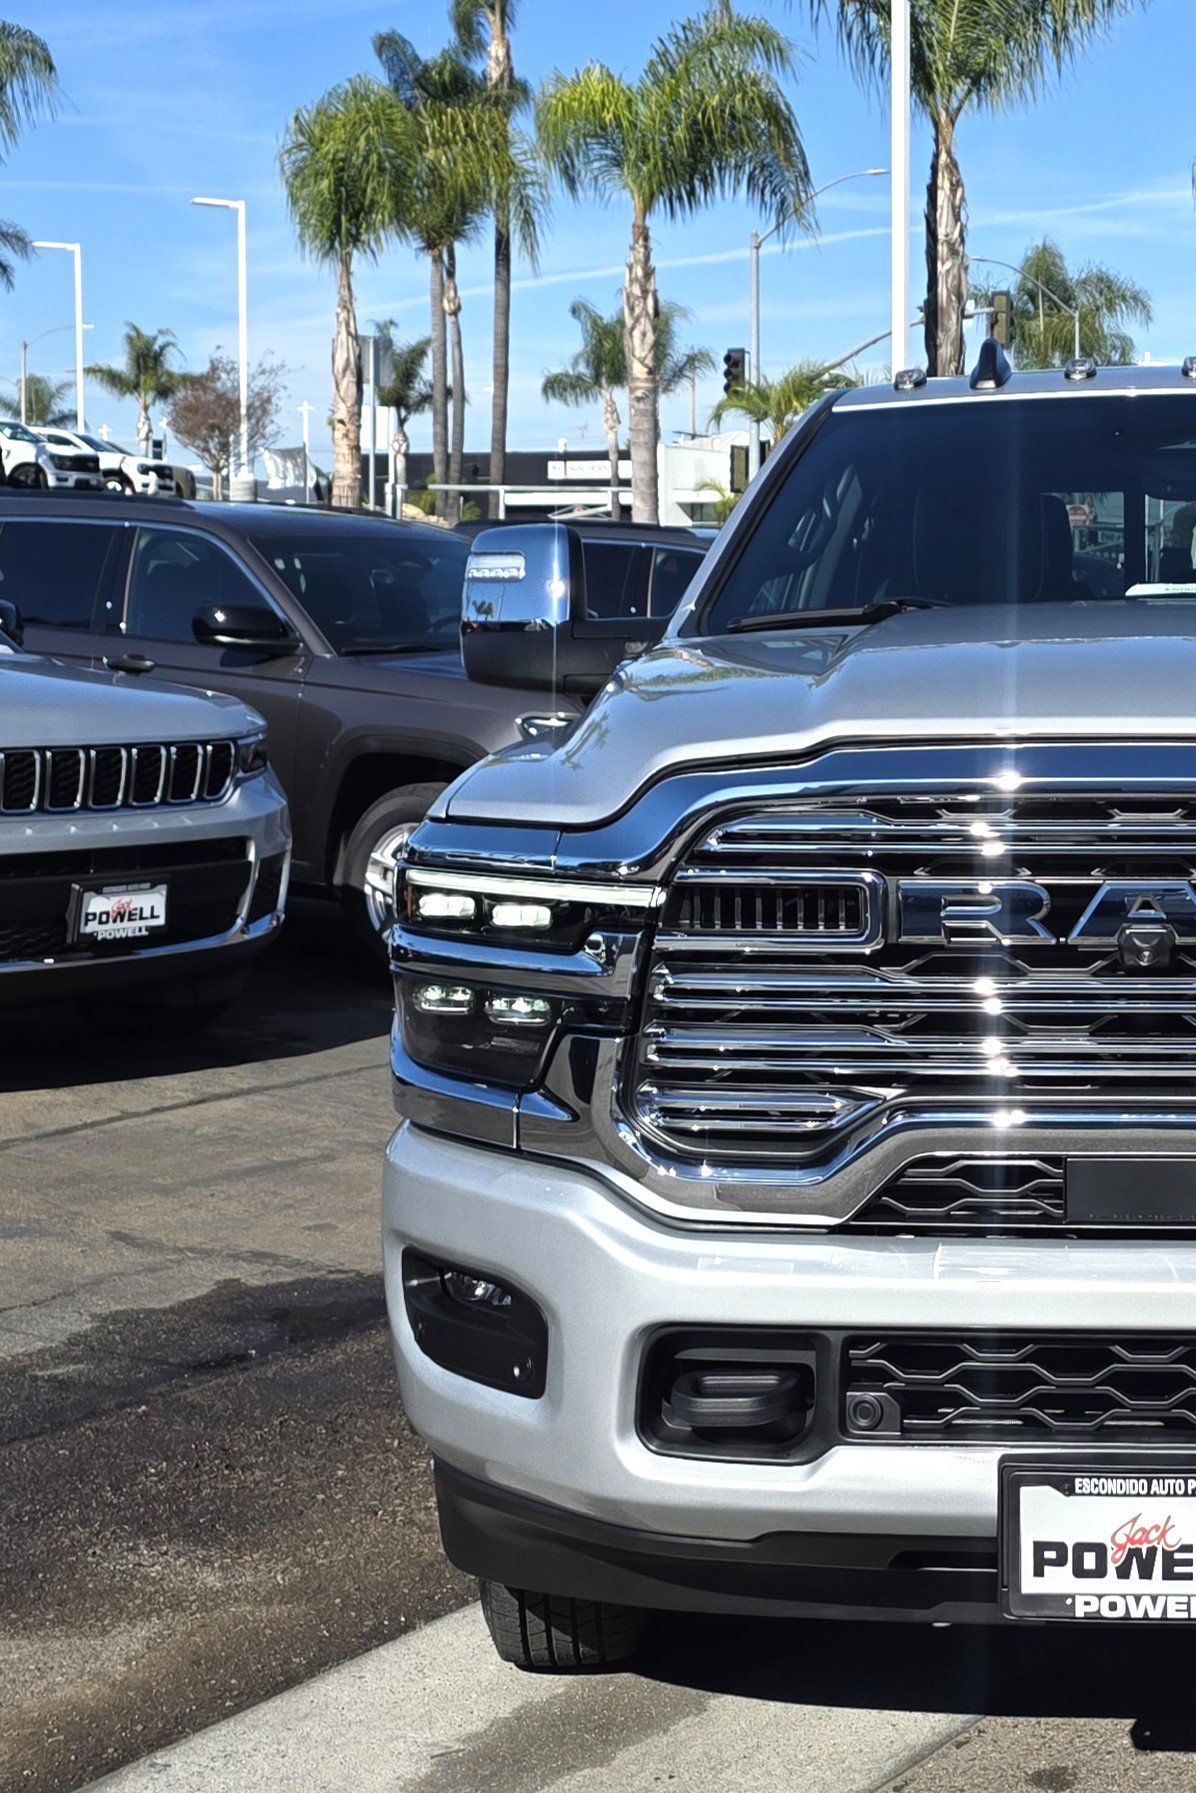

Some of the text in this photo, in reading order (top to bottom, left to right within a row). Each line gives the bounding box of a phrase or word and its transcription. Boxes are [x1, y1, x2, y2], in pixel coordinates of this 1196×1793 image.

[84, 905, 160, 927] POWELL
[97, 926, 150, 941] POWELL
[1074, 1477, 1148, 1496] ESCONDIDO
[1150, 1478, 1185, 1496] AUTO
[1110, 1512, 1182, 1565] Jack
